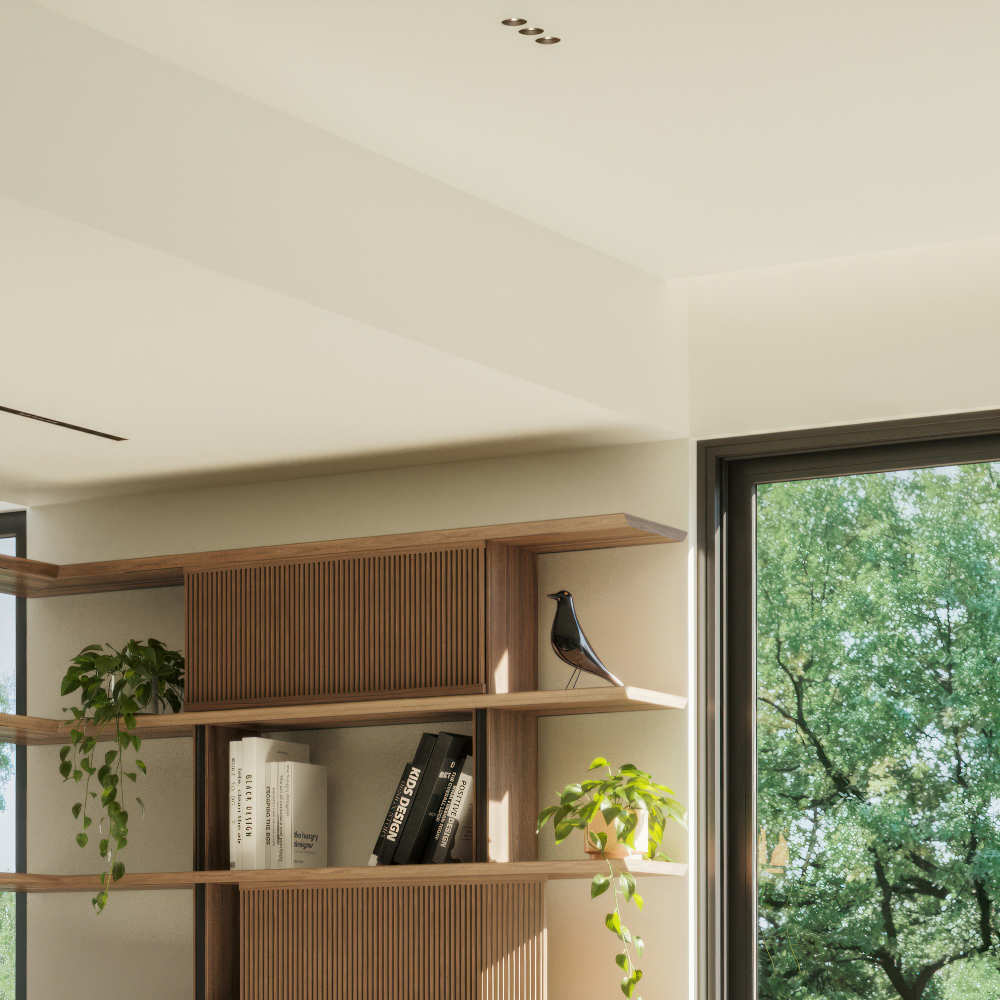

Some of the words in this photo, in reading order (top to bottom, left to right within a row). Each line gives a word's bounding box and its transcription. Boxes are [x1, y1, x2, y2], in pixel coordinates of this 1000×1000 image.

[403, 766, 422, 797] KIDS
[450, 779, 467, 817] POSITIVE
[245, 806, 253, 837] DESIGN
[386, 796, 411, 843] DESIGN
[439, 816, 455, 849] DESIGN
